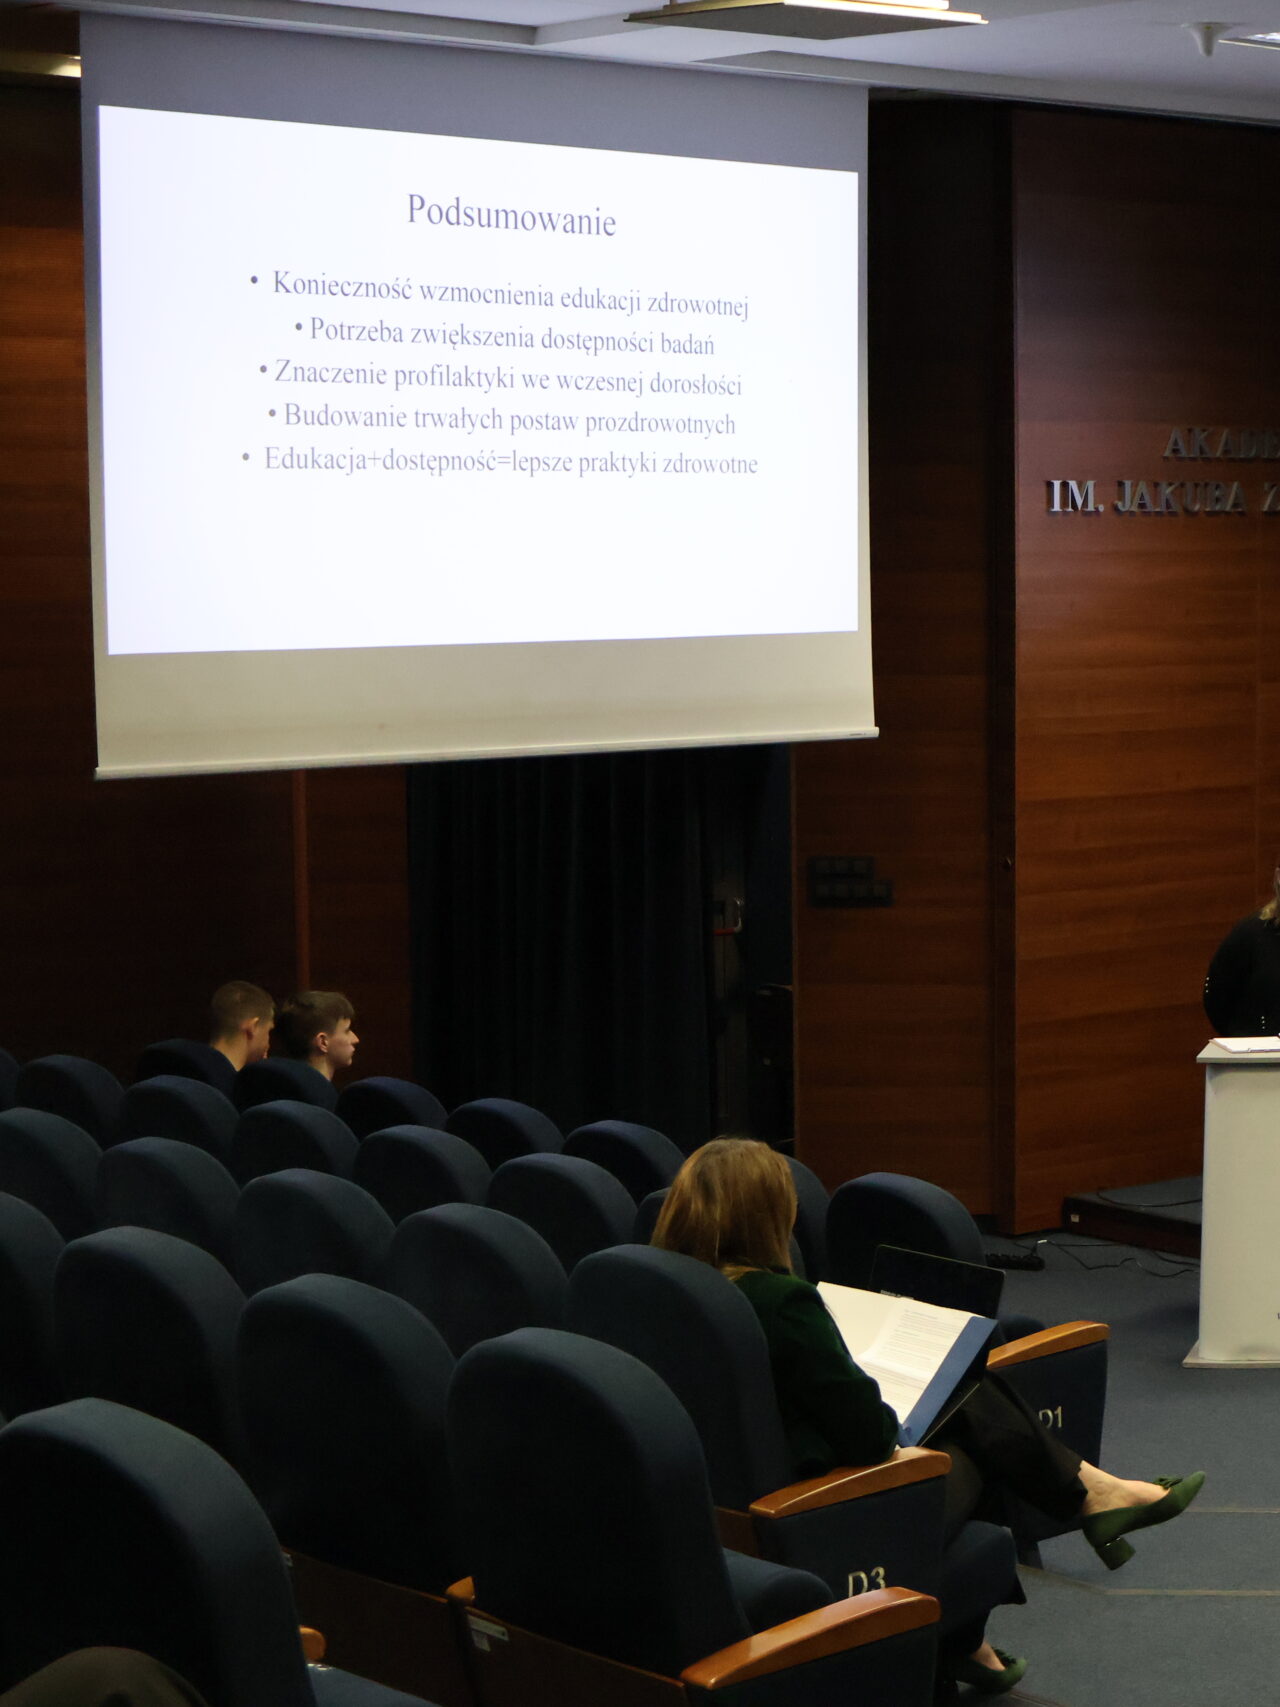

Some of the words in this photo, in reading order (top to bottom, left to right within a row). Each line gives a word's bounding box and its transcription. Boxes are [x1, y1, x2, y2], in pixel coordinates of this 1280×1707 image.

[406, 193, 616, 237] Podsumowanie
[272, 270, 413, 300] Konieczność
[418, 282, 554, 307] wzmocnienia
[560, 286, 641, 317] edukacji
[648, 291, 748, 323] zdrowotnej
[310, 316, 404, 343] Potrzeba
[411, 322, 535, 352] zwiększenia
[541, 326, 654, 357] dostępności
[661, 332, 714, 355] badań
[274, 358, 388, 385] Znaczenie
[394, 363, 514, 394] profilaktyki
[521, 374, 550, 389] we
[556, 371, 643, 398] wczesnej
[649, 371, 742, 395] dorosłości
[284, 402, 408, 428] Budowanie
[414, 406, 503, 435] trwałych
[510, 412, 579, 436] postaw
[586, 410, 735, 440] prozdrowotnych
[264, 446, 572, 478] Edukacja+dostępność=lepsze
[579, 451, 656, 479] praktyki
[662, 452, 758, 474] zdrowotne
[1049, 479, 1105, 513] IM.
[1114, 480, 1245, 513] JAKUBA
[1039, 1405, 1062, 1429] D1
[848, 1566, 886, 1598] D3
